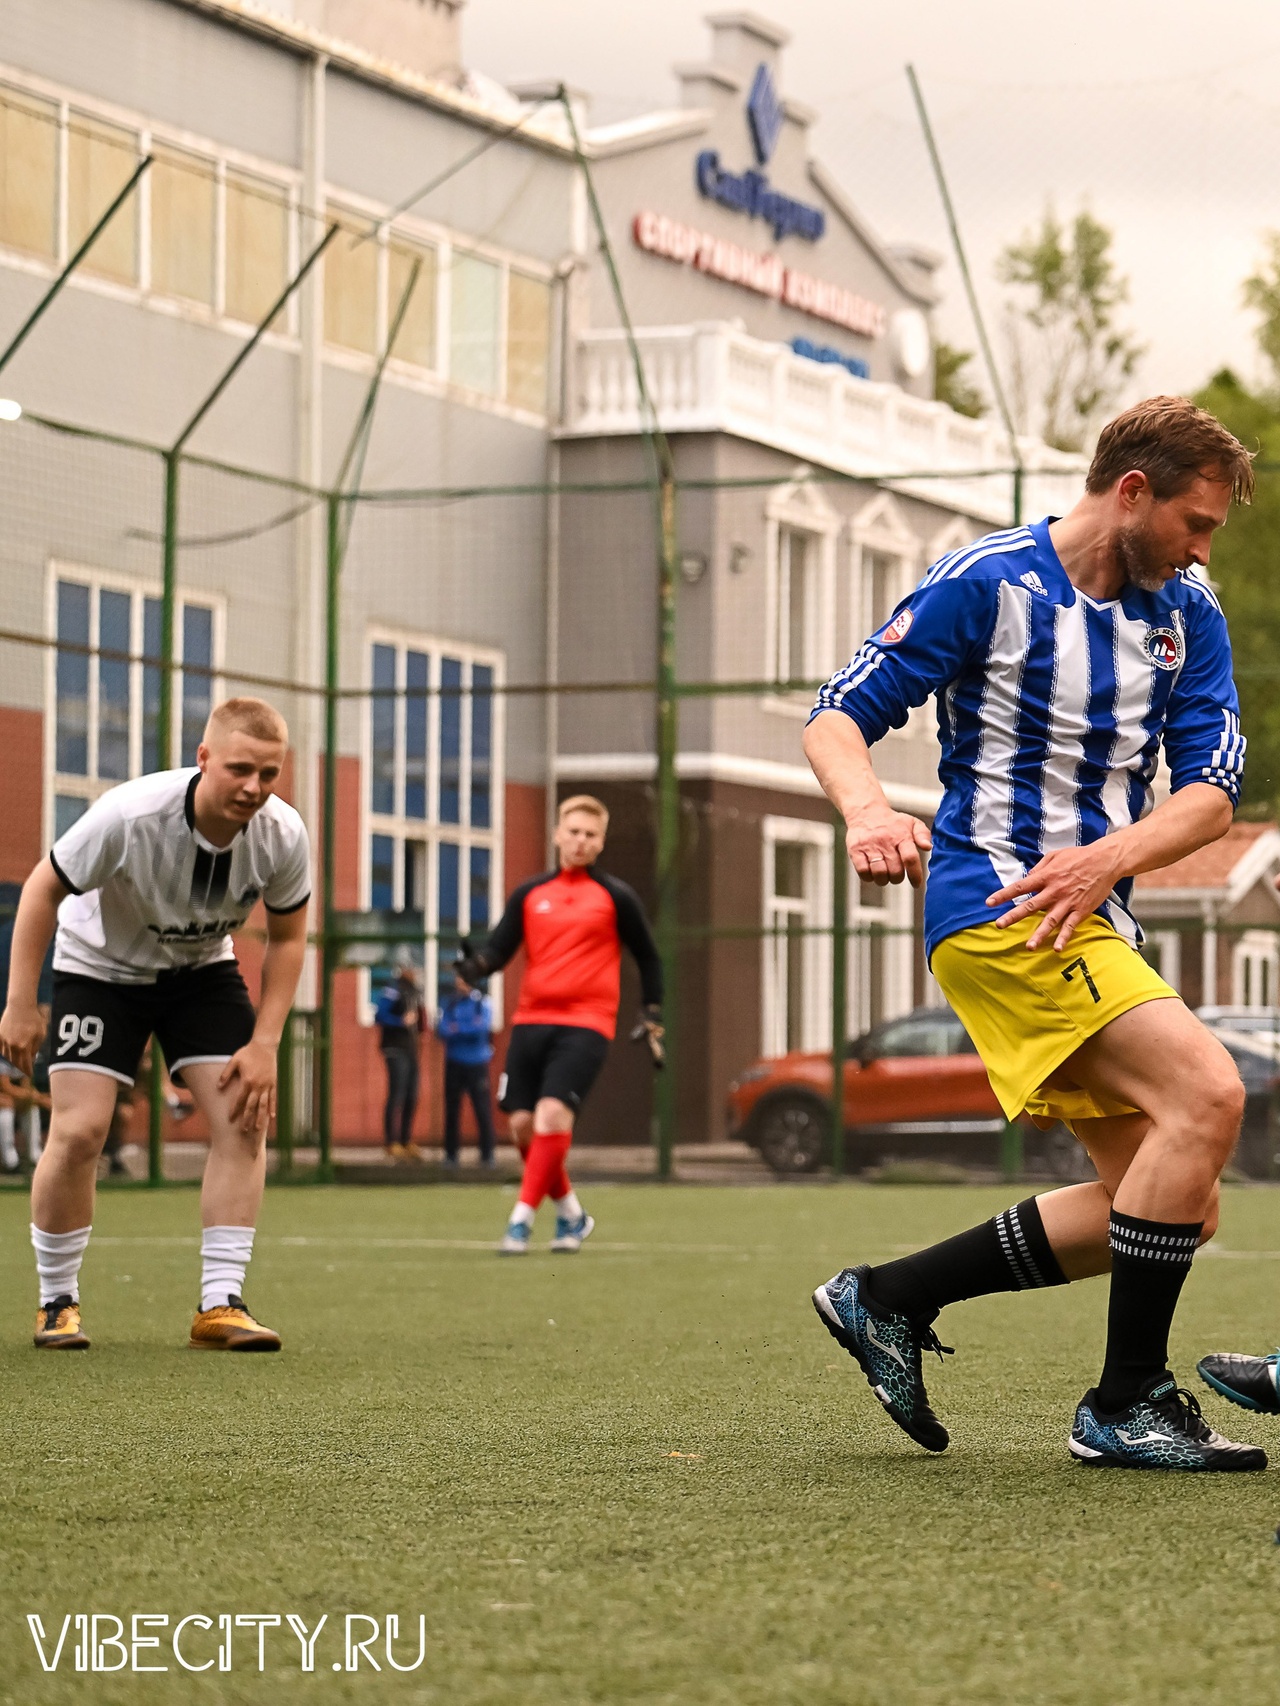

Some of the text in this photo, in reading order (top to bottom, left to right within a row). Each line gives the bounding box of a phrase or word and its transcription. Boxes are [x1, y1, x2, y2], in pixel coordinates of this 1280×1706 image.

[632, 210, 783, 299] СПОРТИВНЫЙ
[1060, 956, 1102, 1004] 7
[56, 1014, 104, 1058] 99
[1153, 1382, 1175, 1398] Joma
